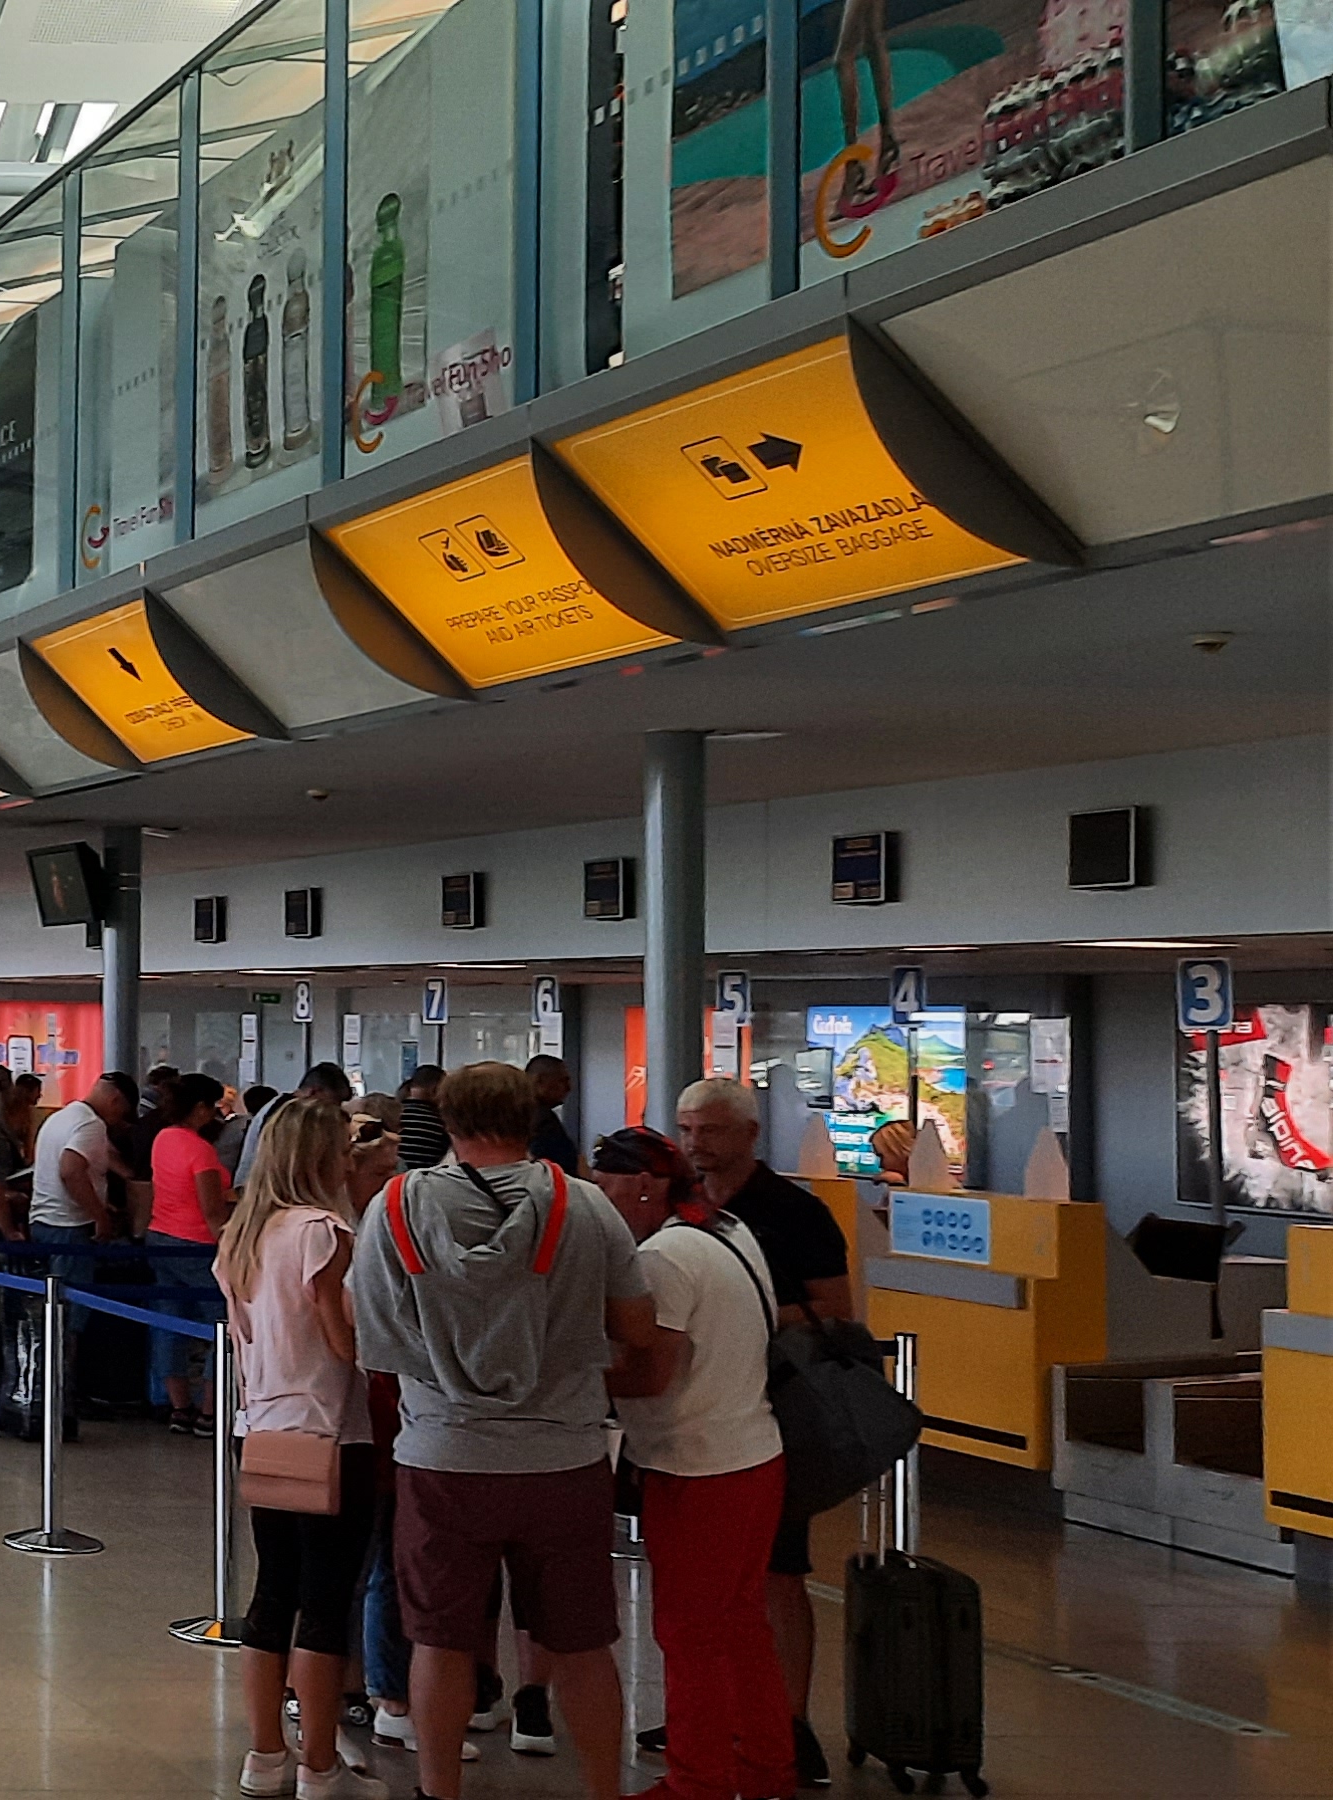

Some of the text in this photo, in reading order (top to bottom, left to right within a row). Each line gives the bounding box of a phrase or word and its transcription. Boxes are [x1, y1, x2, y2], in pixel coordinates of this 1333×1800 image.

[709, 490, 930, 559] NADMĚRNÁ ZAVAZADLA
[747, 518, 934, 577] OVERSIZE BAGGAGE
[445, 605, 505, 631] PREPARE
[500, 595, 540, 617] YOUR
[485, 626, 514, 645] AND
[534, 604, 594, 631] TICKETS
[296, 982, 311, 1018] 8
[427, 980, 443, 1019] 7
[536, 979, 554, 1013] 6
[723, 976, 746, 1019] 5
[893, 971, 919, 1013] 4
[1187, 964, 1224, 1023] 3
